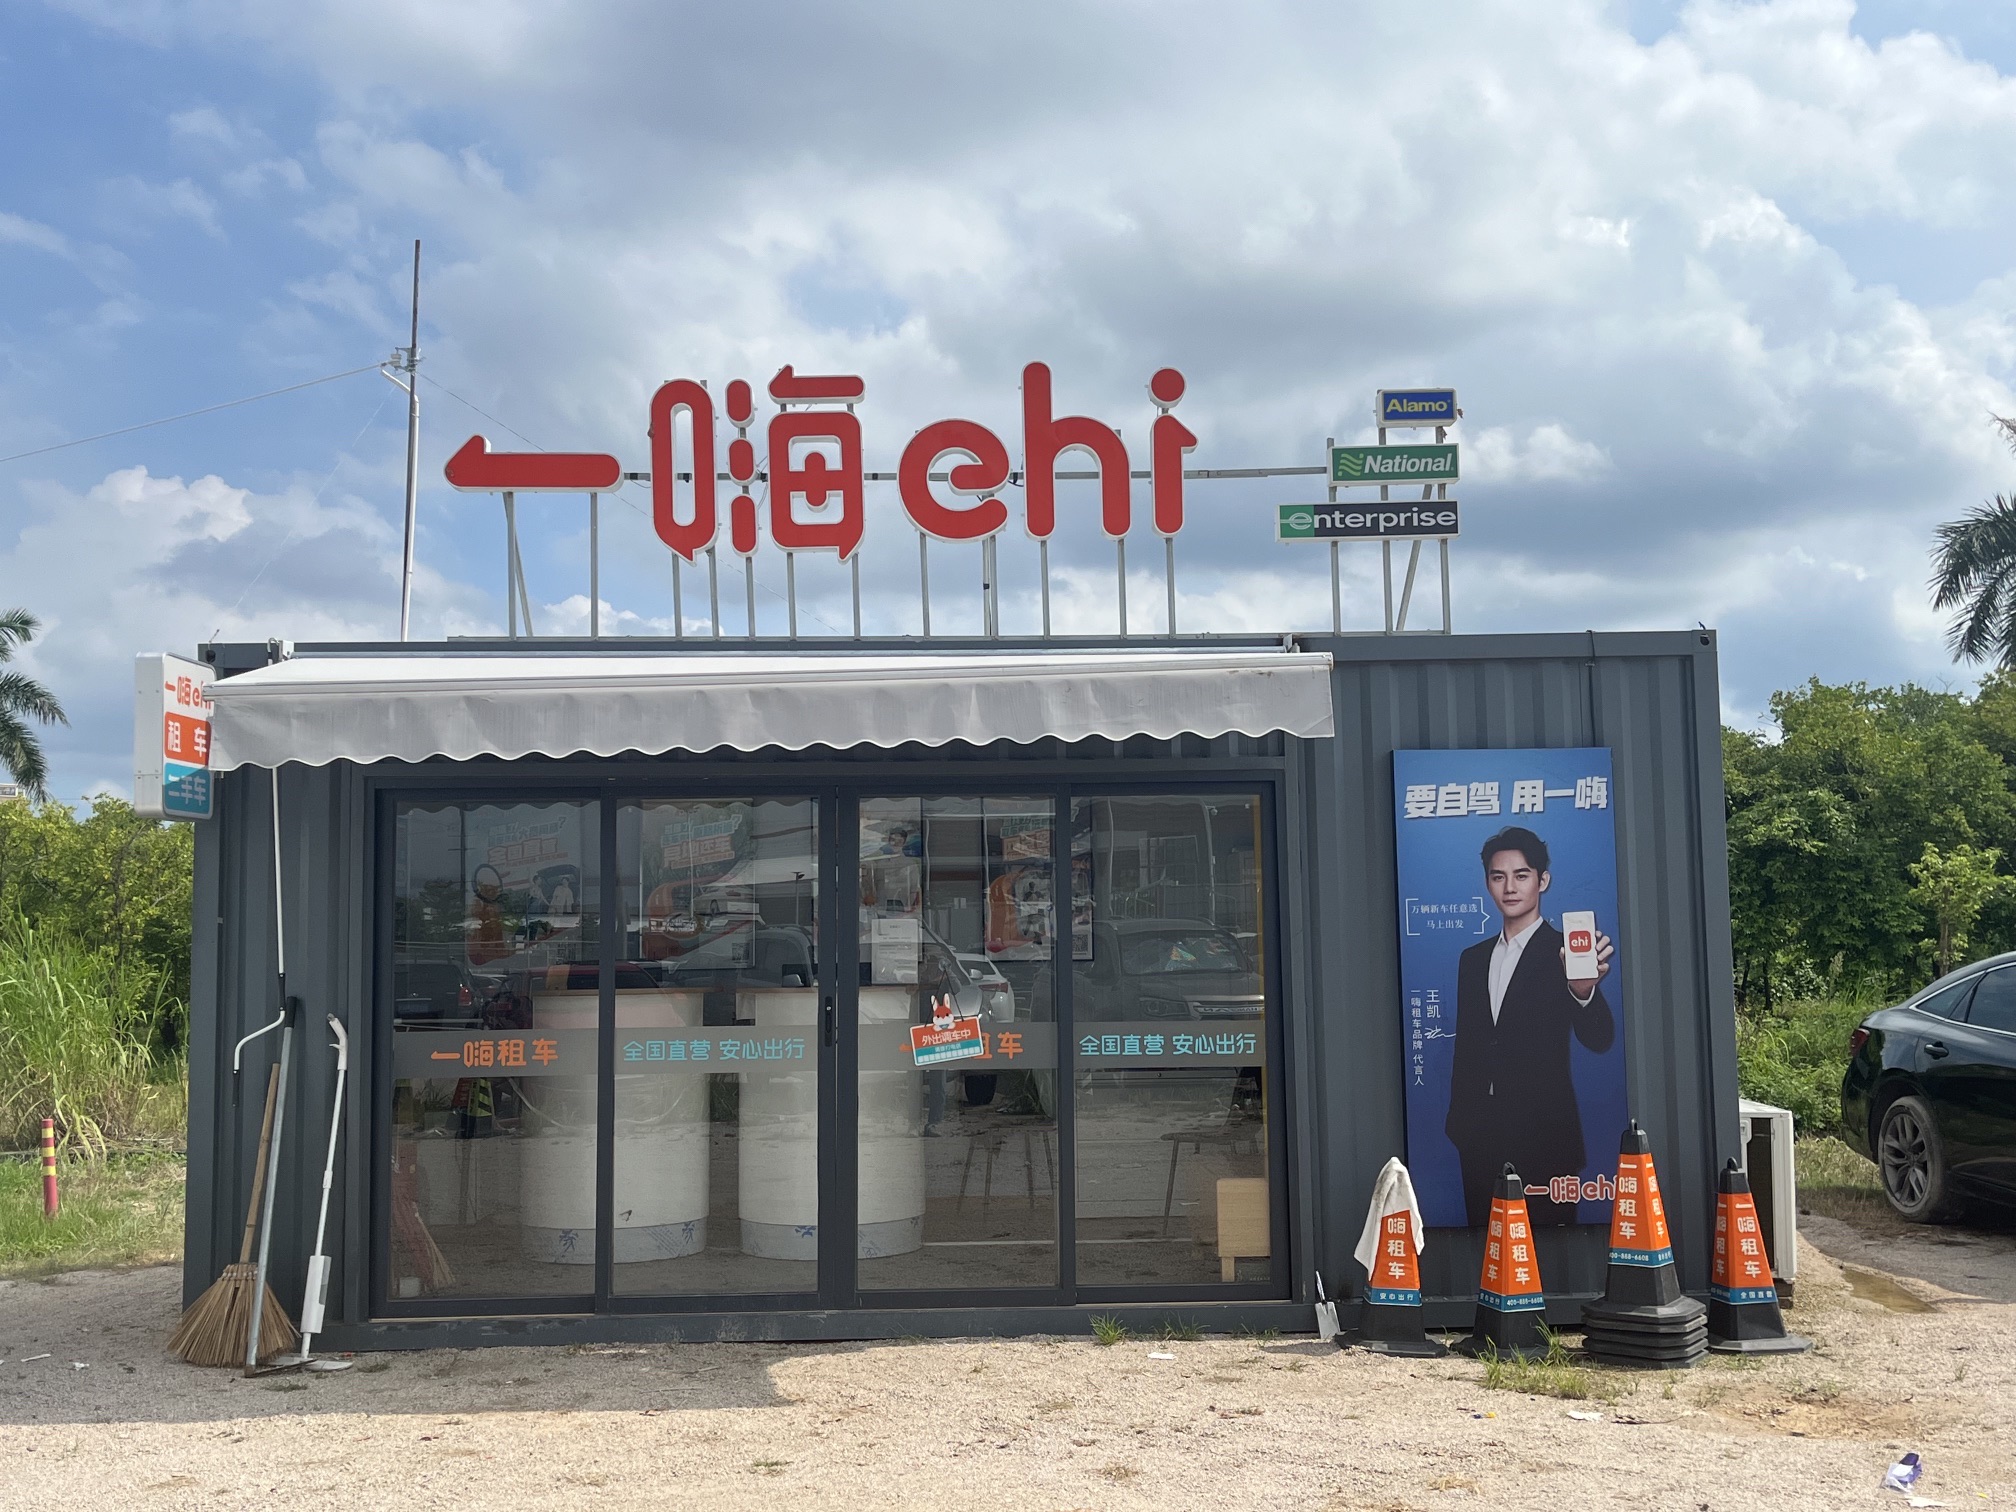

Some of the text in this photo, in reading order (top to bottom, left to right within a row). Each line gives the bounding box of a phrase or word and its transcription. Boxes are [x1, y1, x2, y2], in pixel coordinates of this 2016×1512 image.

[1386, 399, 1448, 413] Alamo
[1364, 453, 1452, 473] National
[1282, 507, 1456, 533] enterprise
[167, 720, 207, 758] 租车
[1404, 776, 1608, 819] 要自驾 用一嗨
[1411, 903, 1478, 914] 万辆新车任意选
[1426, 919, 1464, 930] 马上出发
[1571, 936, 1589, 948] ehi
[1426, 989, 1440, 1018] 王凯
[623, 1038, 805, 1061] 全国直营 安心出行
[921, 1028, 972, 1047] 外出调车中
[1079, 1033, 1257, 1056] 全国直营 安心出行
[430, 1038, 558, 1068] 一嗨租车
[1524, 1174, 1617, 1204] 一嗨eh
[1619, 1163, 1638, 1240] 一嗨租车
[1387, 1217, 1406, 1280] 嗨租车
[1487, 1206, 1503, 1282] 一嗨租车
[1508, 1209, 1530, 1285] 一嗨租车
[1735, 1203, 1761, 1278] 一嗨租车
[1380, 1292, 1414, 1301] 安心出行
